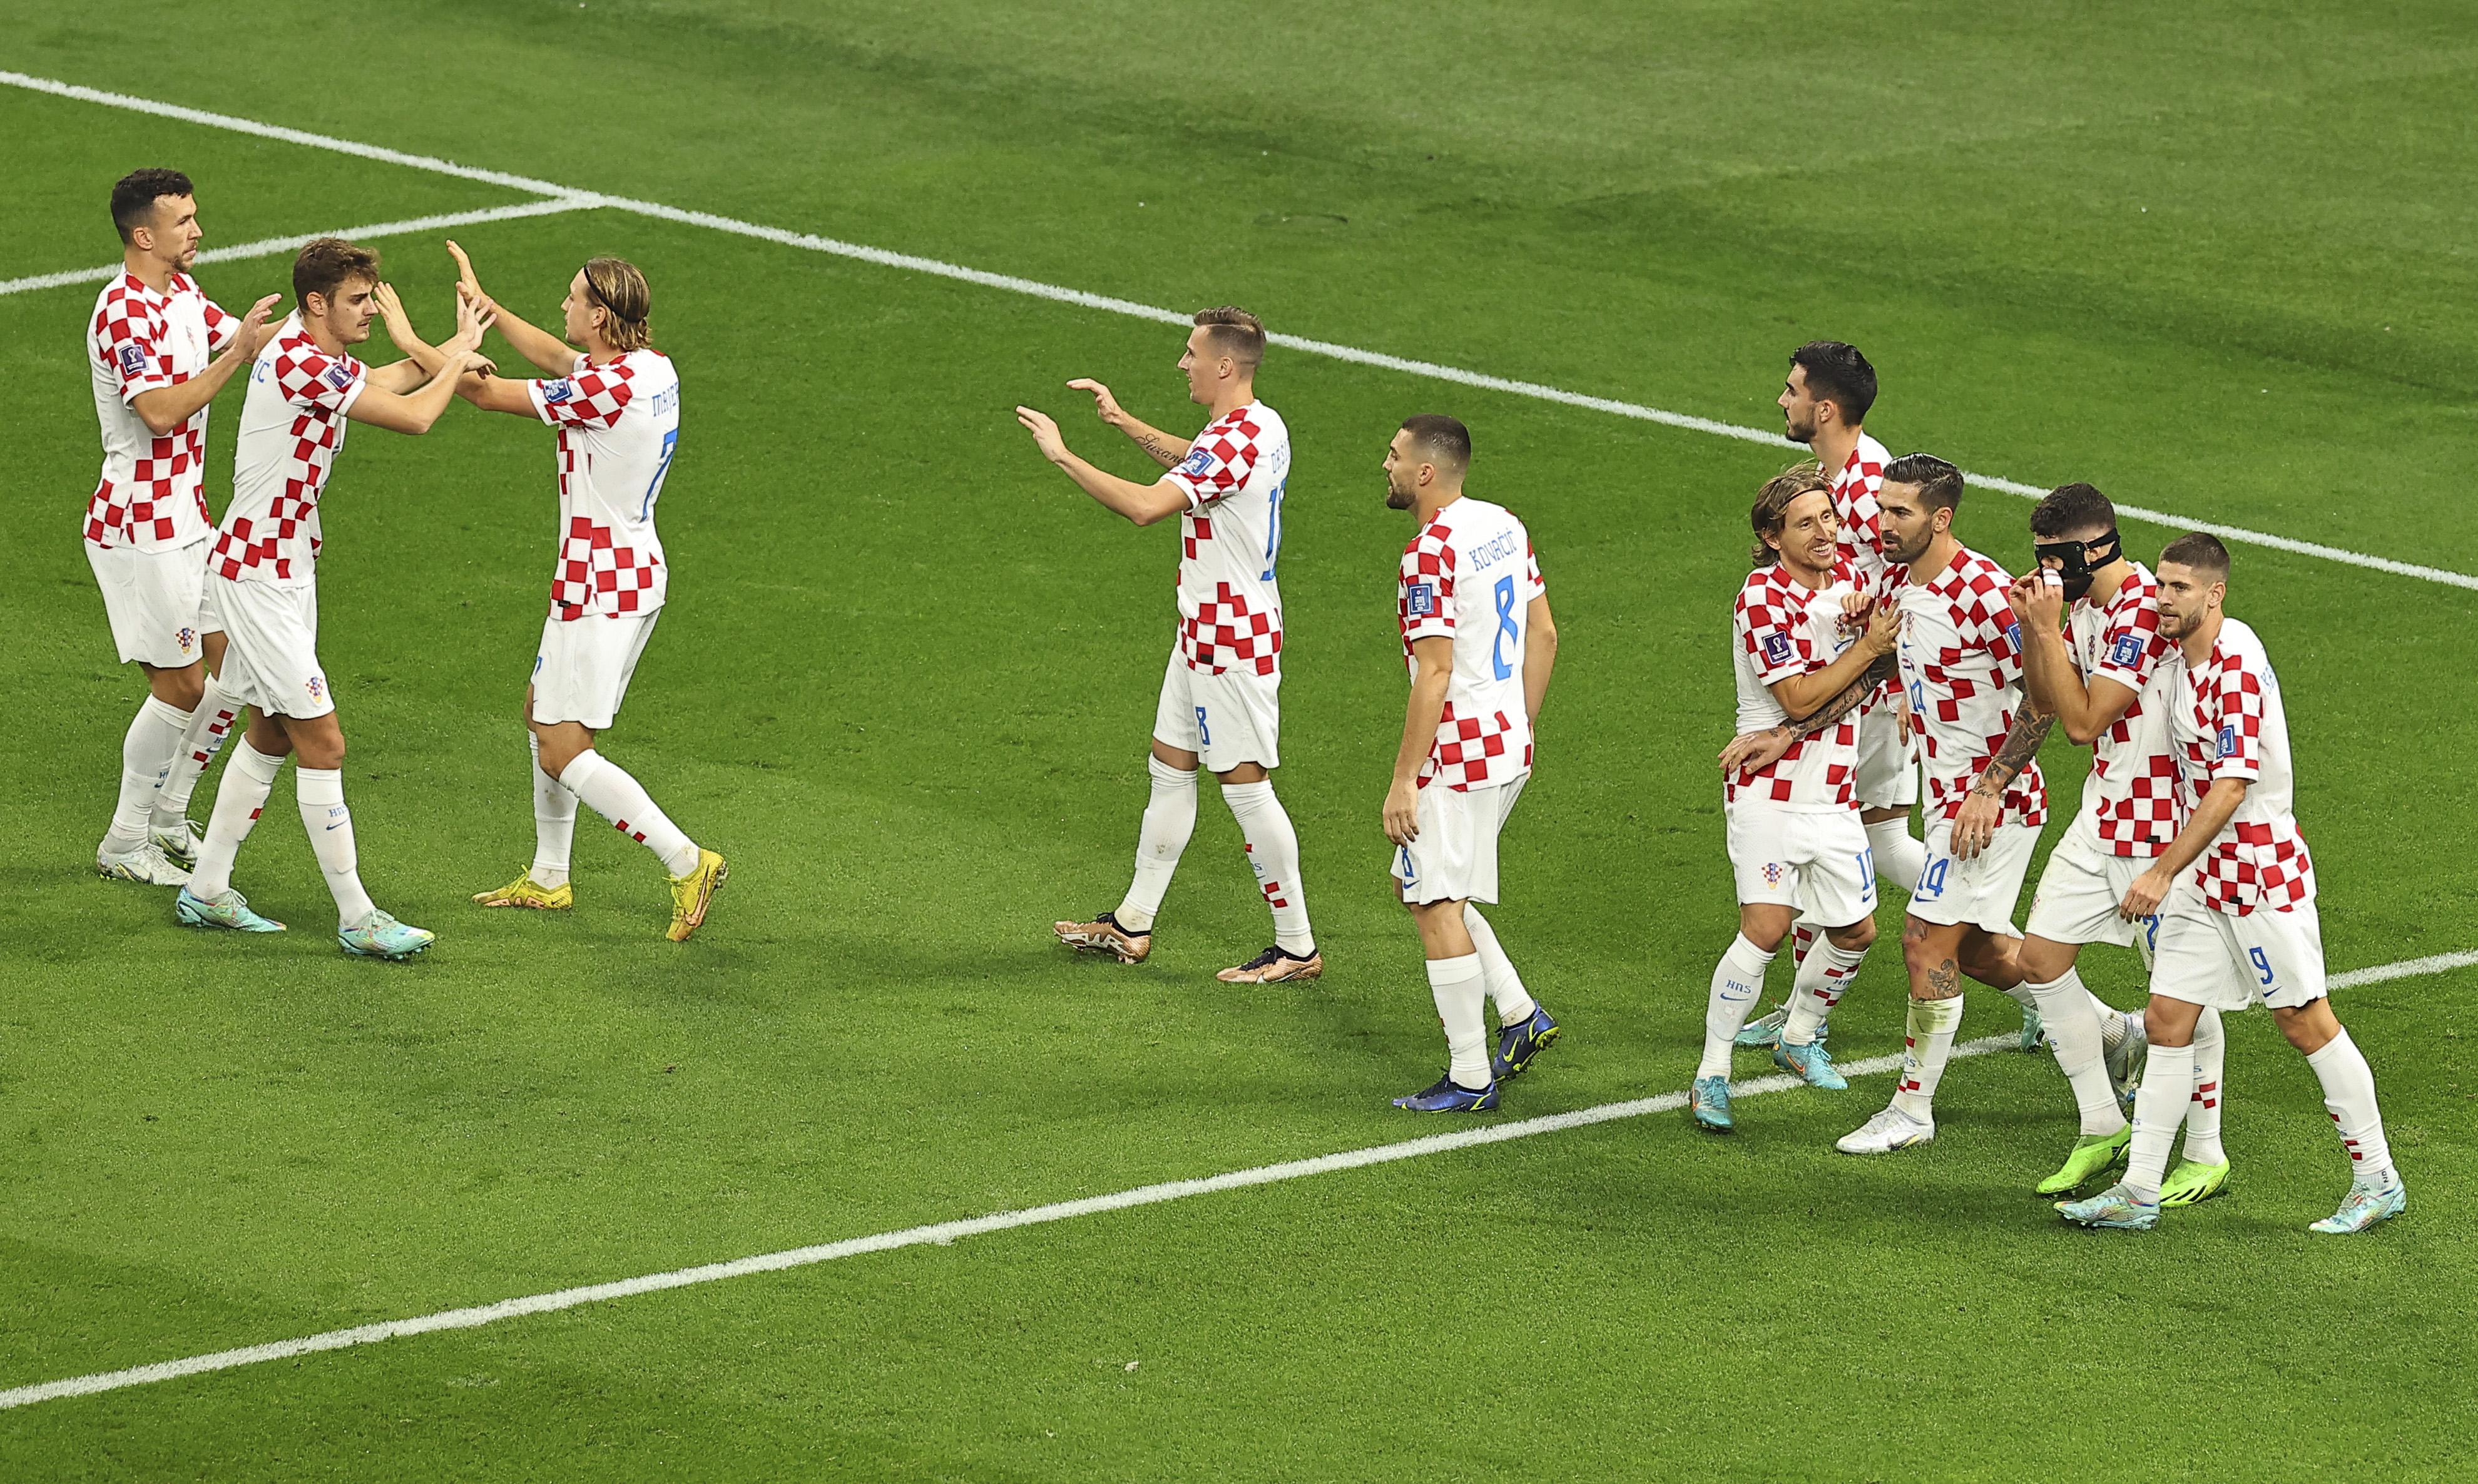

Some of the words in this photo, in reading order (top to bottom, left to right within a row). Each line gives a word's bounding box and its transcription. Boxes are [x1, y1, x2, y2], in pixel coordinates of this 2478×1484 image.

[639, 428, 679, 523] 7
[1492, 574, 1518, 681] 8
[1917, 852, 1944, 897] 14
[1726, 979, 1751, 994] HNS
[2248, 946, 2273, 985] 9
